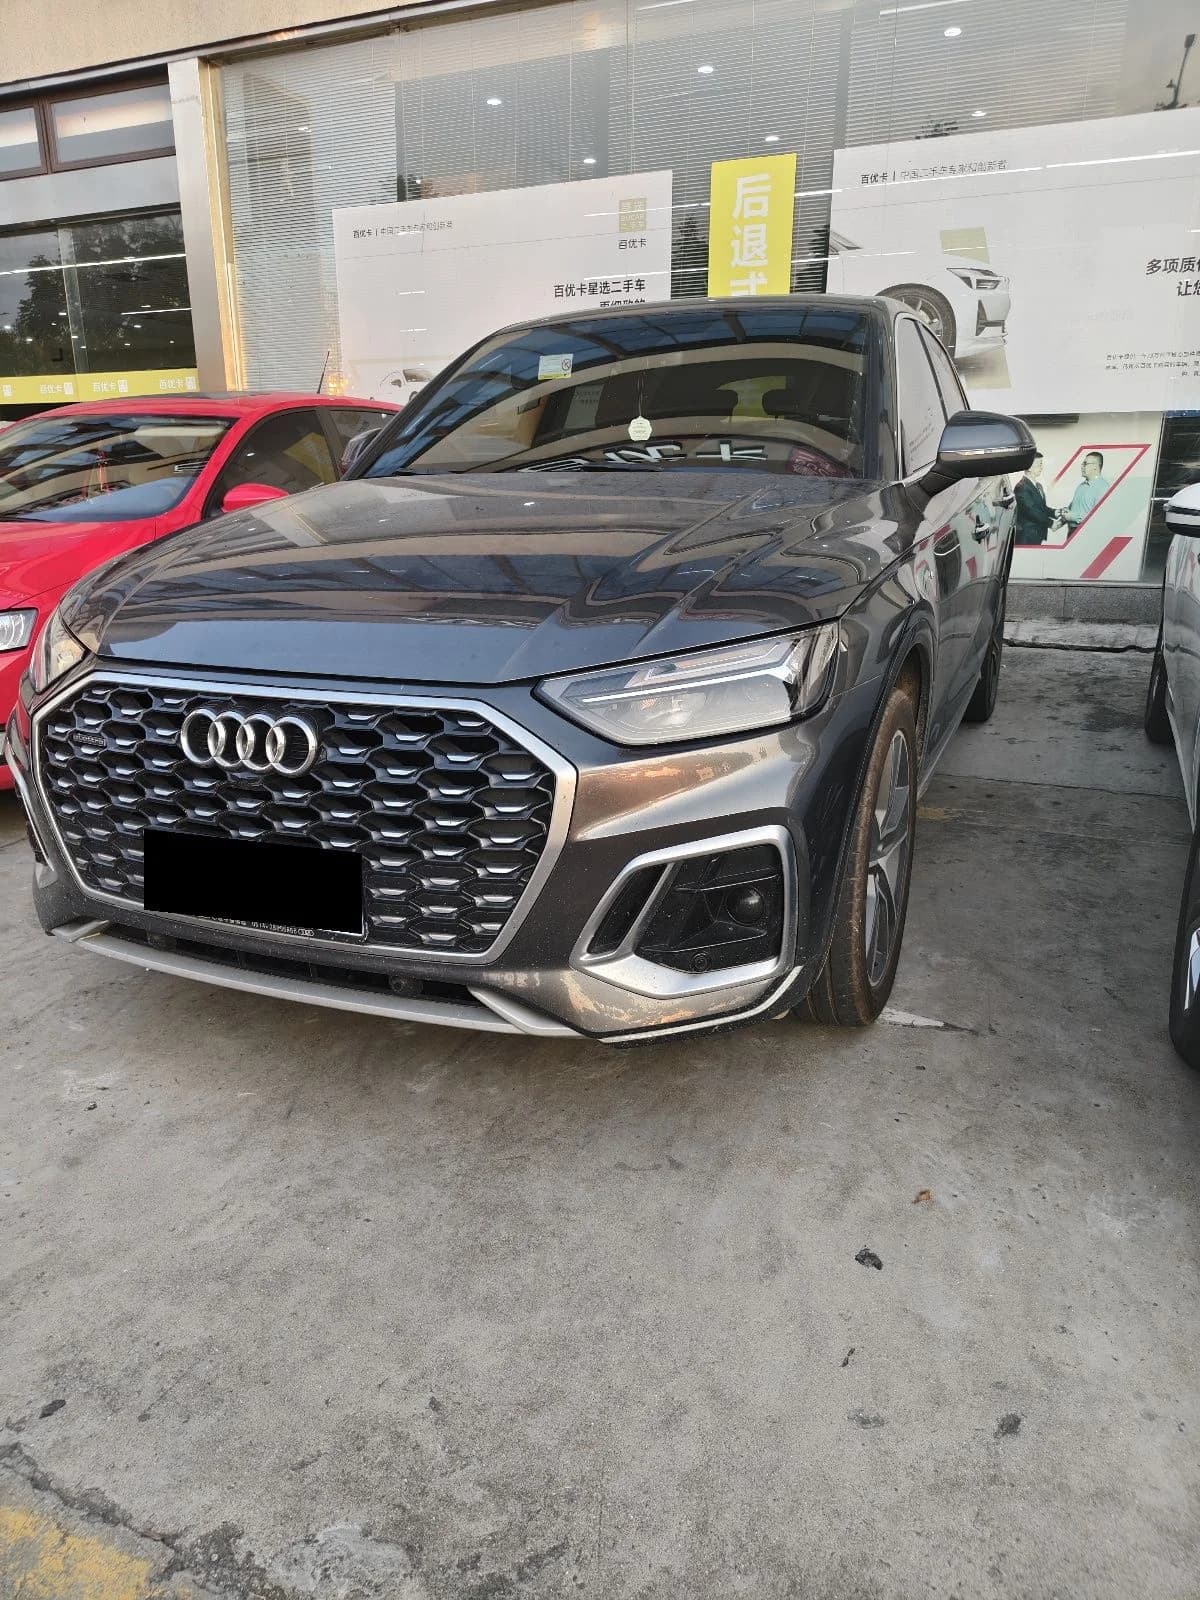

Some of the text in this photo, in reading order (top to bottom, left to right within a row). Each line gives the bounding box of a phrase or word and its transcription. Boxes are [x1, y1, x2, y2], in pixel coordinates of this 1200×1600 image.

[860, 172, 889, 184] 百优卡
[619, 238, 647, 249] 百优卡
[553, 278, 646, 298] 百优卡星选二手车
